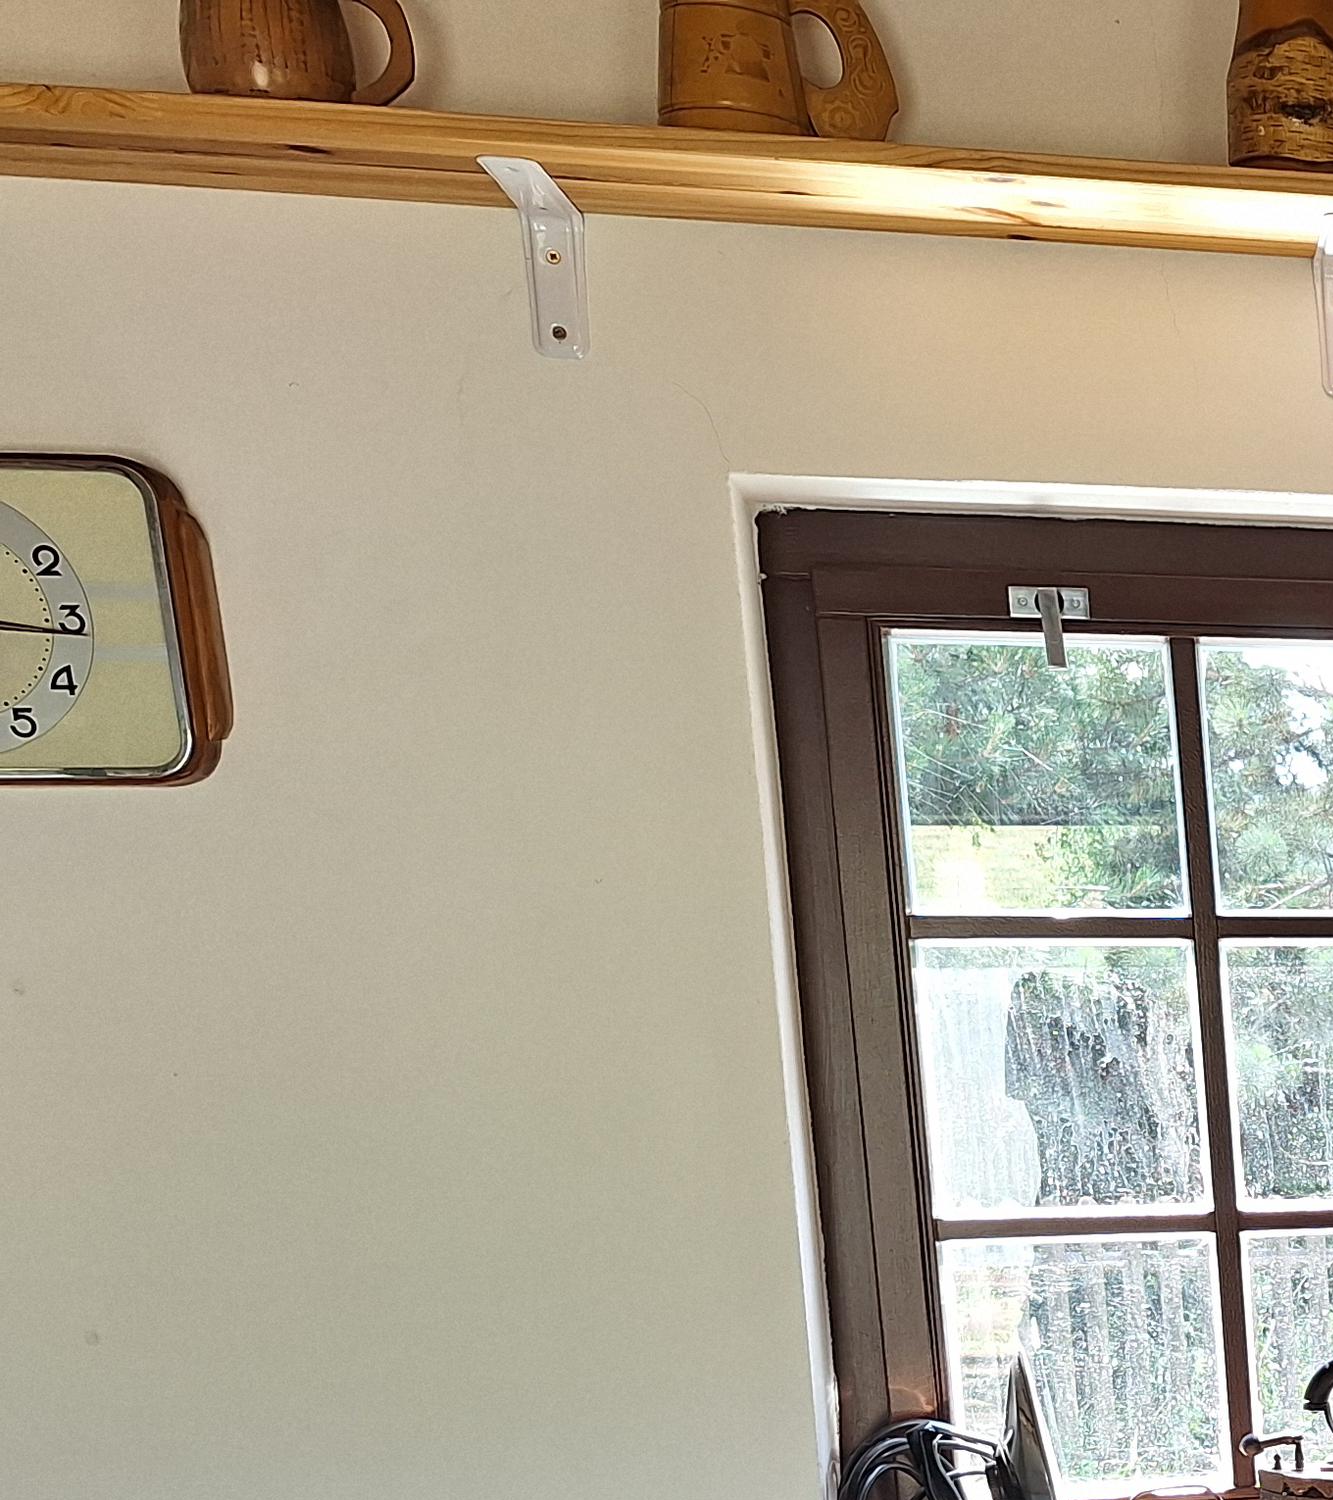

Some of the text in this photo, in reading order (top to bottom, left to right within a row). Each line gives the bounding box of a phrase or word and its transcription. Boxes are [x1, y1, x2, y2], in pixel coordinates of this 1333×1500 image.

[32, 545, 63, 576] 2
[58, 604, 86, 635] 3
[50, 664, 78, 696] 4
[9, 707, 37, 738] 5
